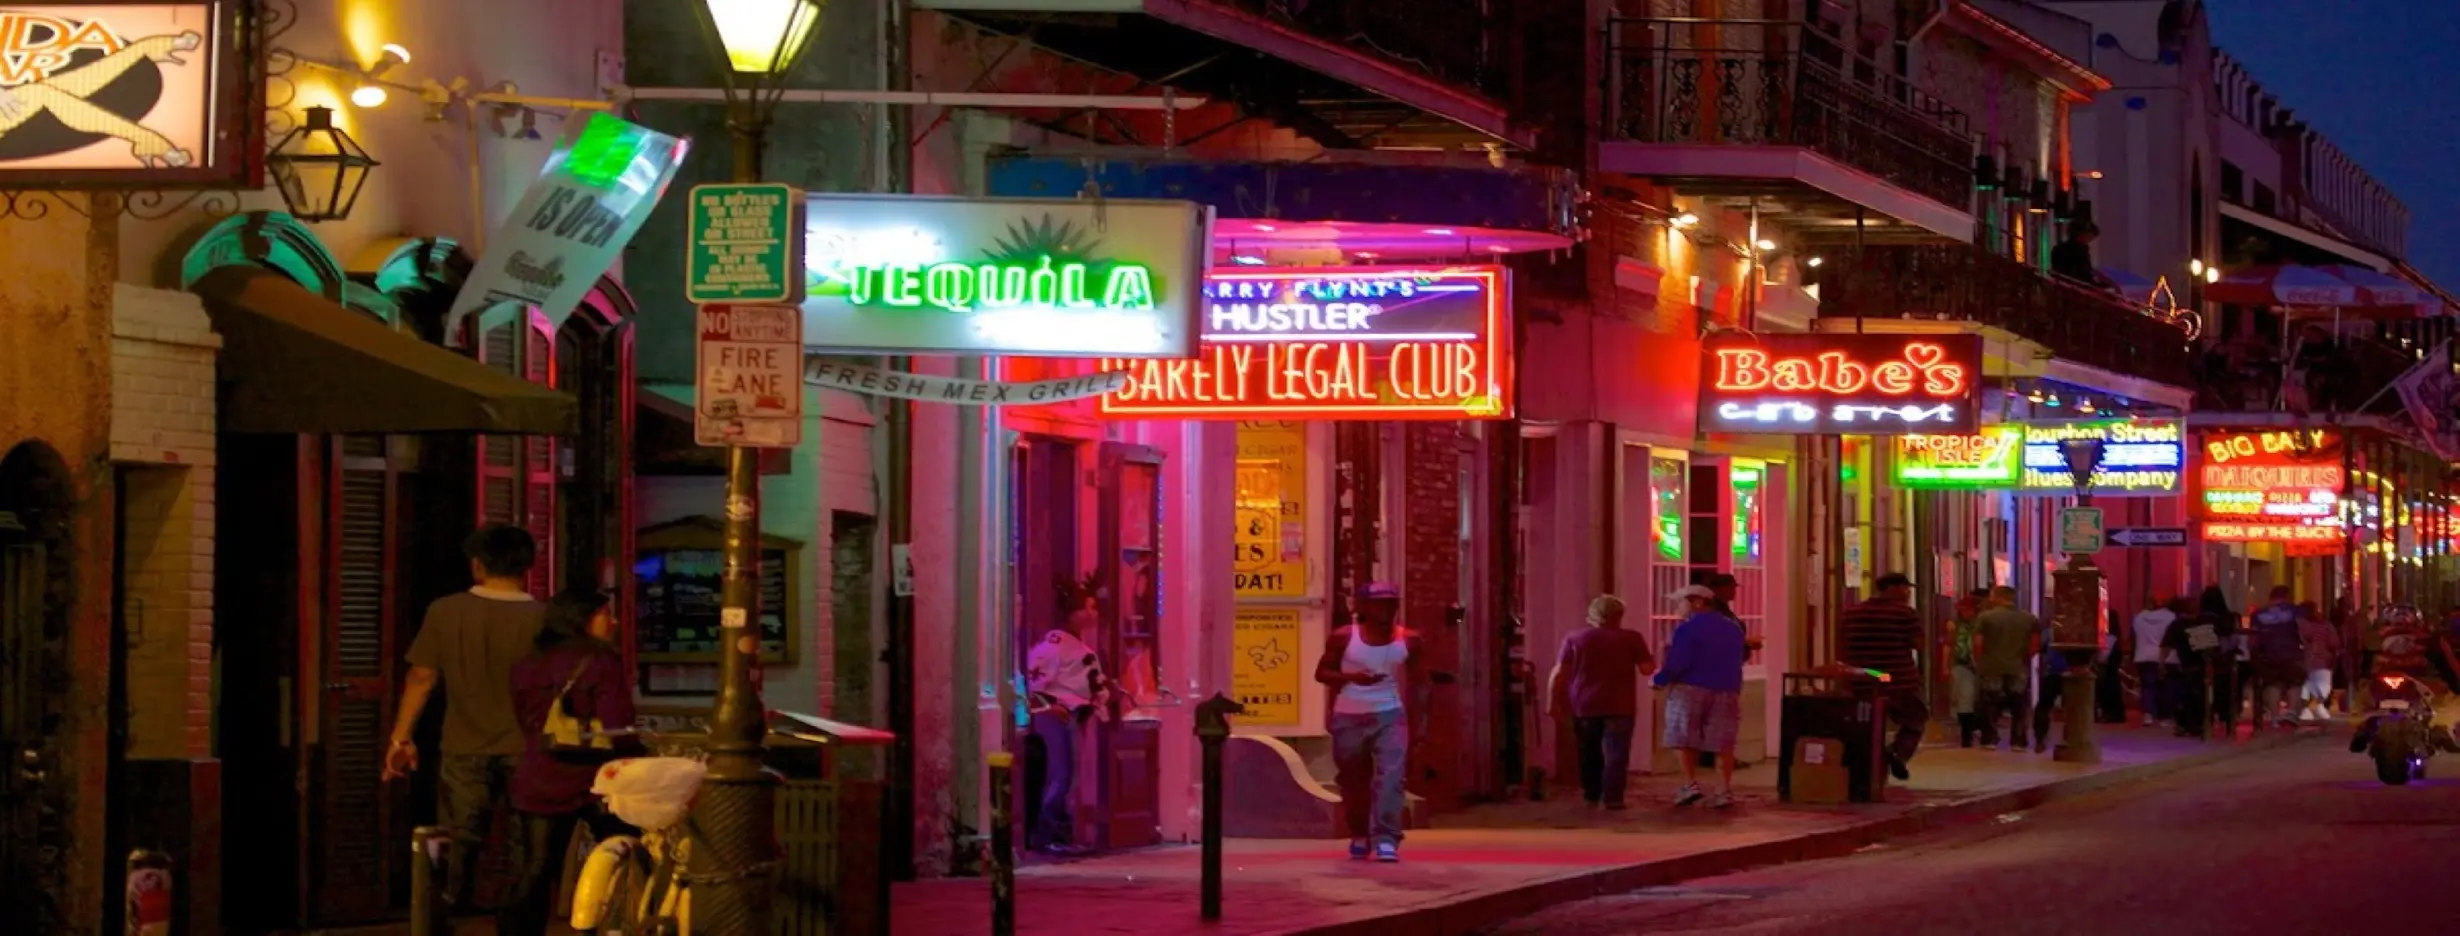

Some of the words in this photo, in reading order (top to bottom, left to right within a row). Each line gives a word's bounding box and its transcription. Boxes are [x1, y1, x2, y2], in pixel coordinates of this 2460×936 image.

[554, 194, 624, 245] OPEN
[850, 256, 1155, 313] TEQUILA
[1294, 280, 1414, 298] FLYNT'S
[701, 310, 730, 335] NO
[734, 324, 794, 338] ANYTIME
[720, 346, 780, 370] FIRE
[1715, 344, 1962, 395] Babe's
[816, 363, 924, 397] FRESH
[943, 381, 1008, 402] MEX
[1027, 370, 1117, 401] GRILL
[1266, 341, 1378, 400] LEGAL
[1388, 341, 1477, 400] CLUB
[2110, 422, 2178, 442] Street
[1936, 449, 1981, 464] ISLE
[2089, 470, 2178, 490] ompany
